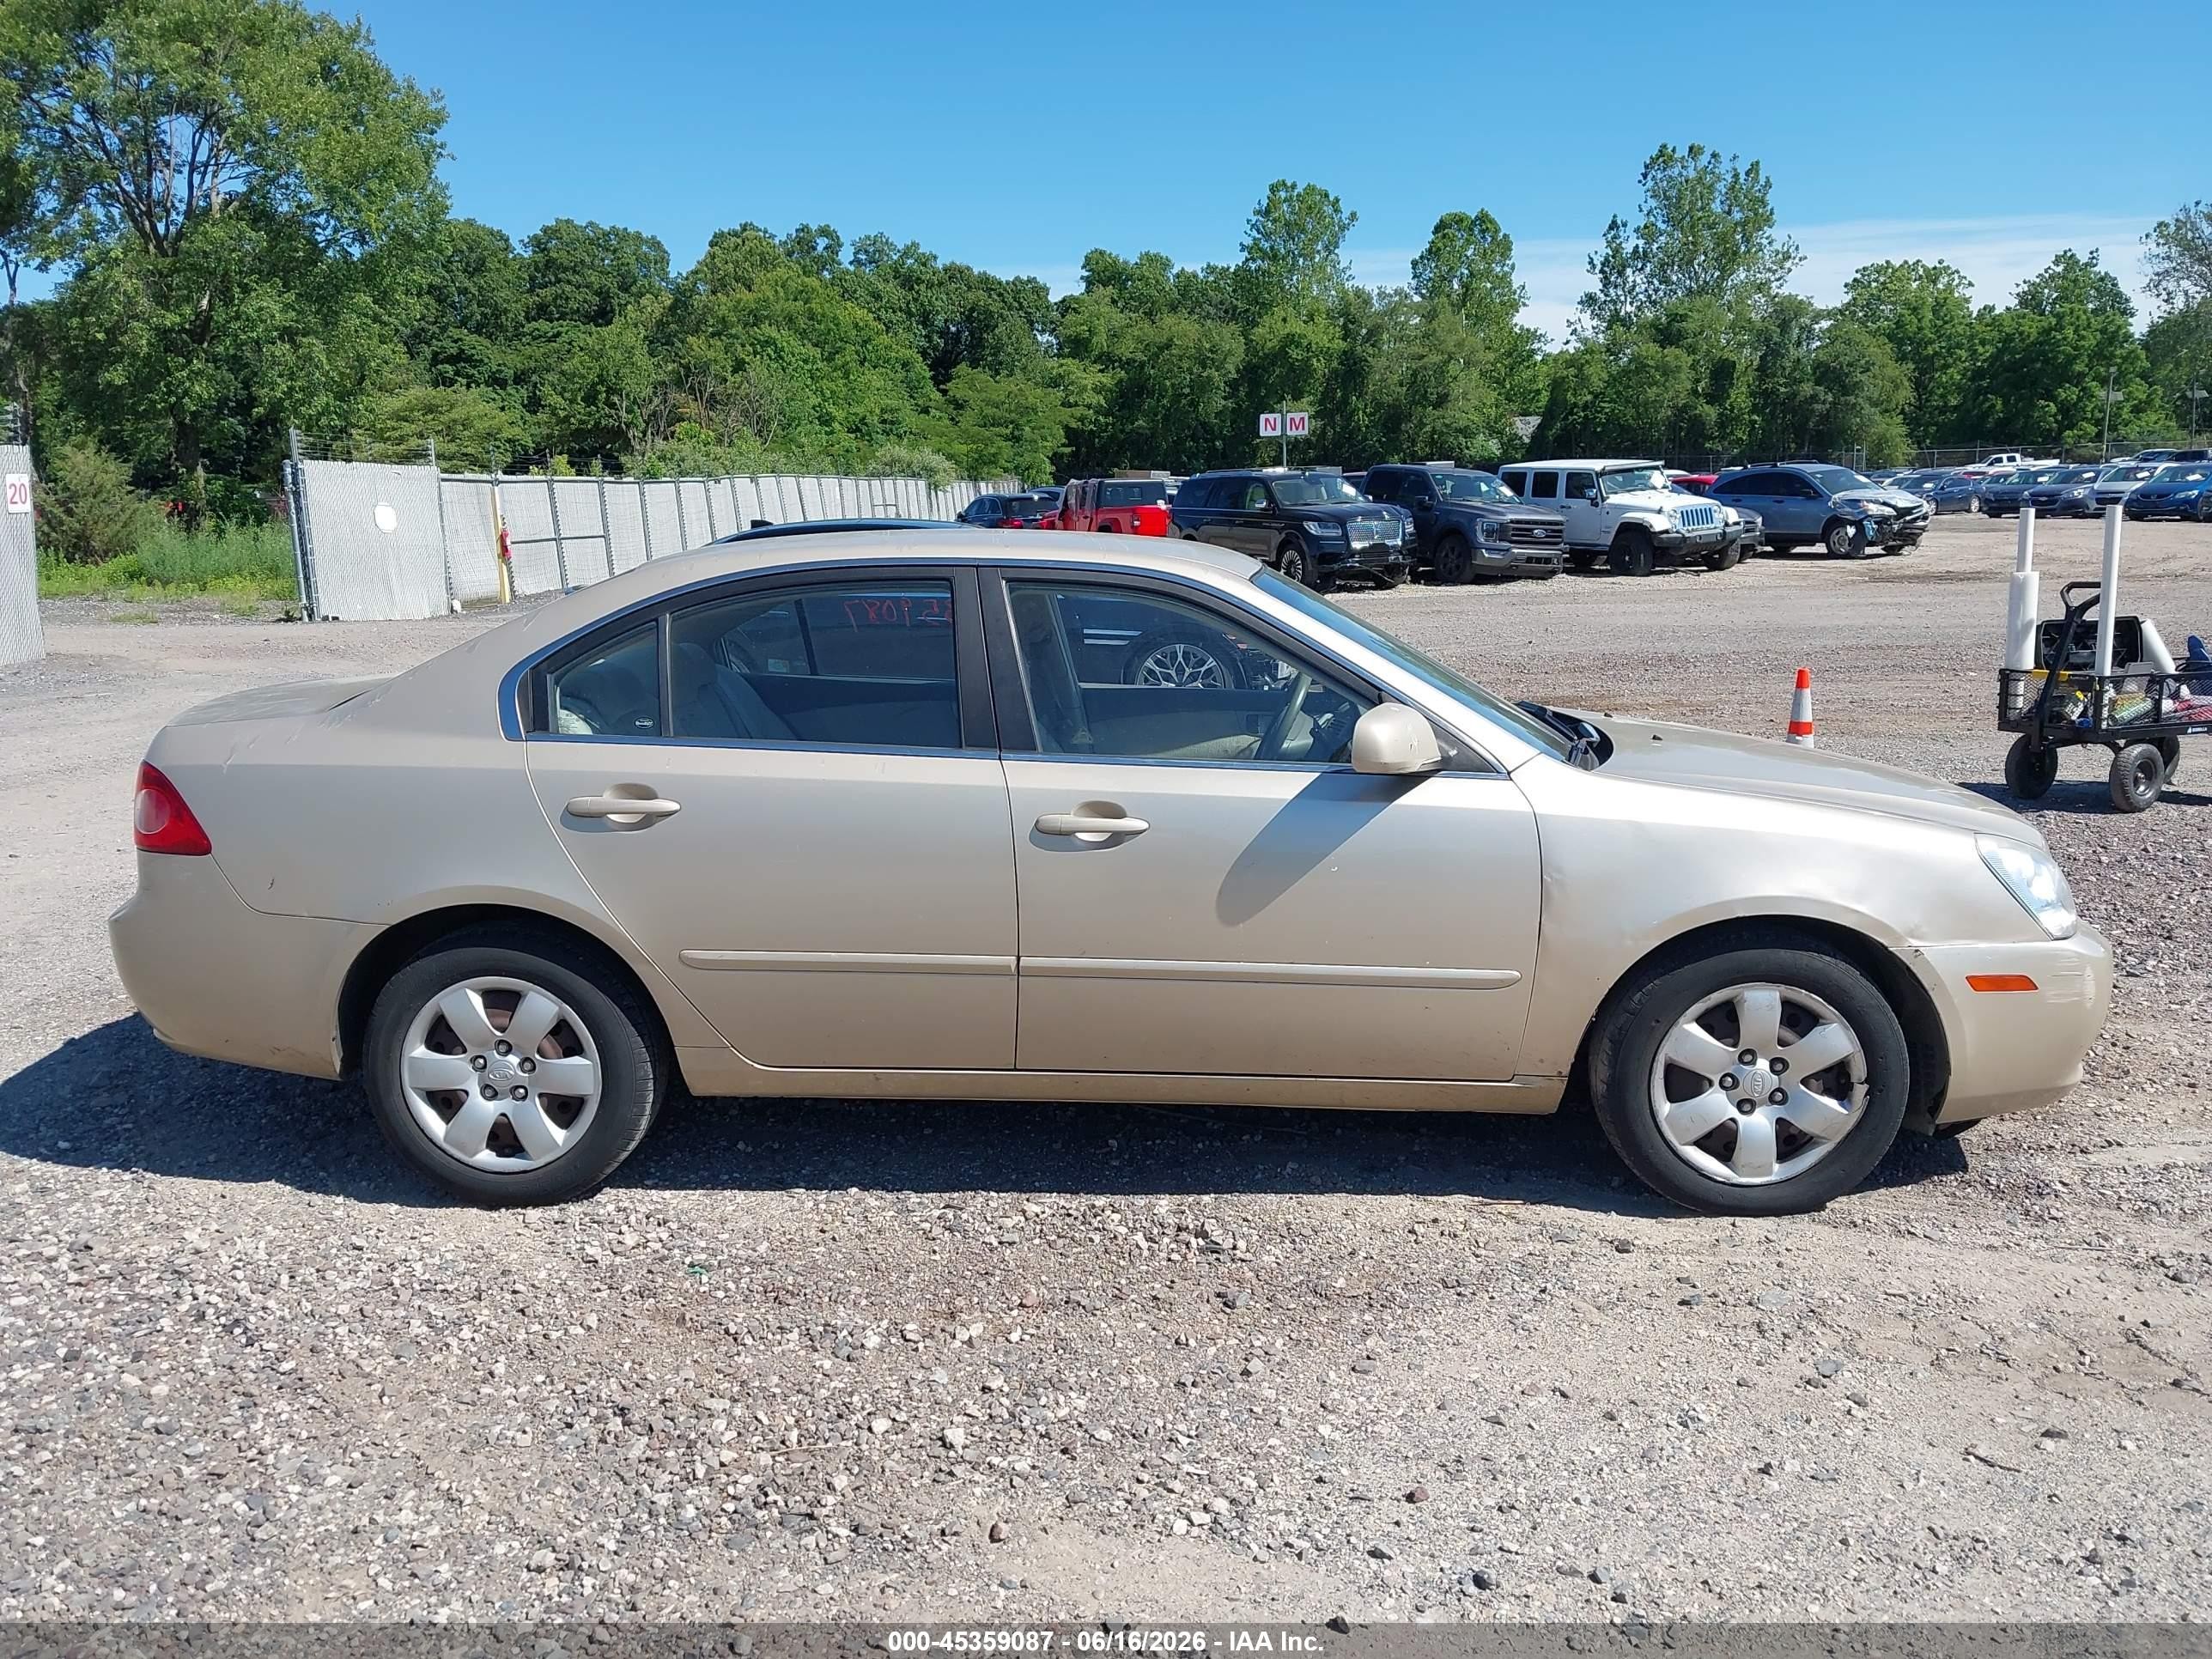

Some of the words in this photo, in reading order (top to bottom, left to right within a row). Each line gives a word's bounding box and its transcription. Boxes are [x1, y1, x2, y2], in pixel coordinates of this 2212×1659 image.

[1264, 417, 1277, 432] N
[1289, 416, 1305, 431] M
[9, 483, 27, 505] 20
